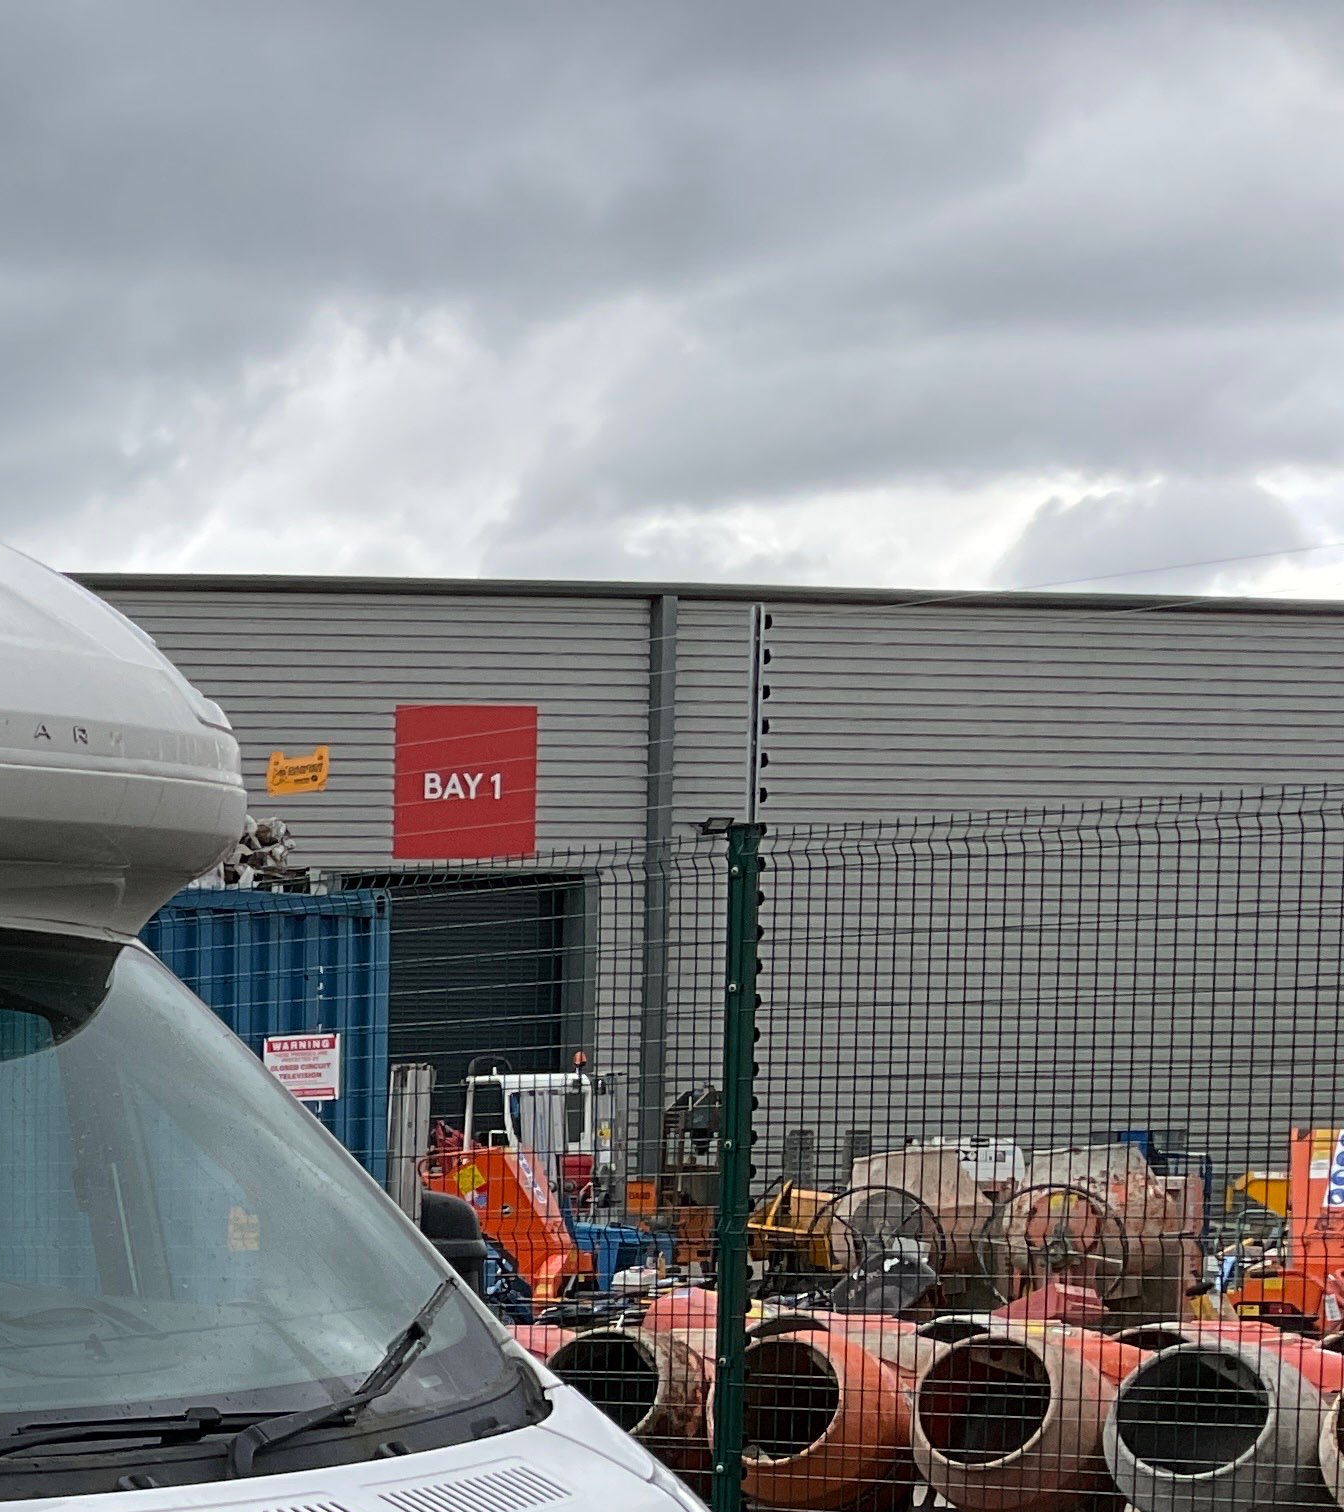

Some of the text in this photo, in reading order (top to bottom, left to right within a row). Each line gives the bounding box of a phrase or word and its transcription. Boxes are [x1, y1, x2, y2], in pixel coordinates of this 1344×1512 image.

[424, 772, 502, 800] BAY 1
[272, 1039, 330, 1051] WARNING
[301, 1062, 332, 1071] CIRCUIT
[278, 1071, 322, 1080] TELEVISION
